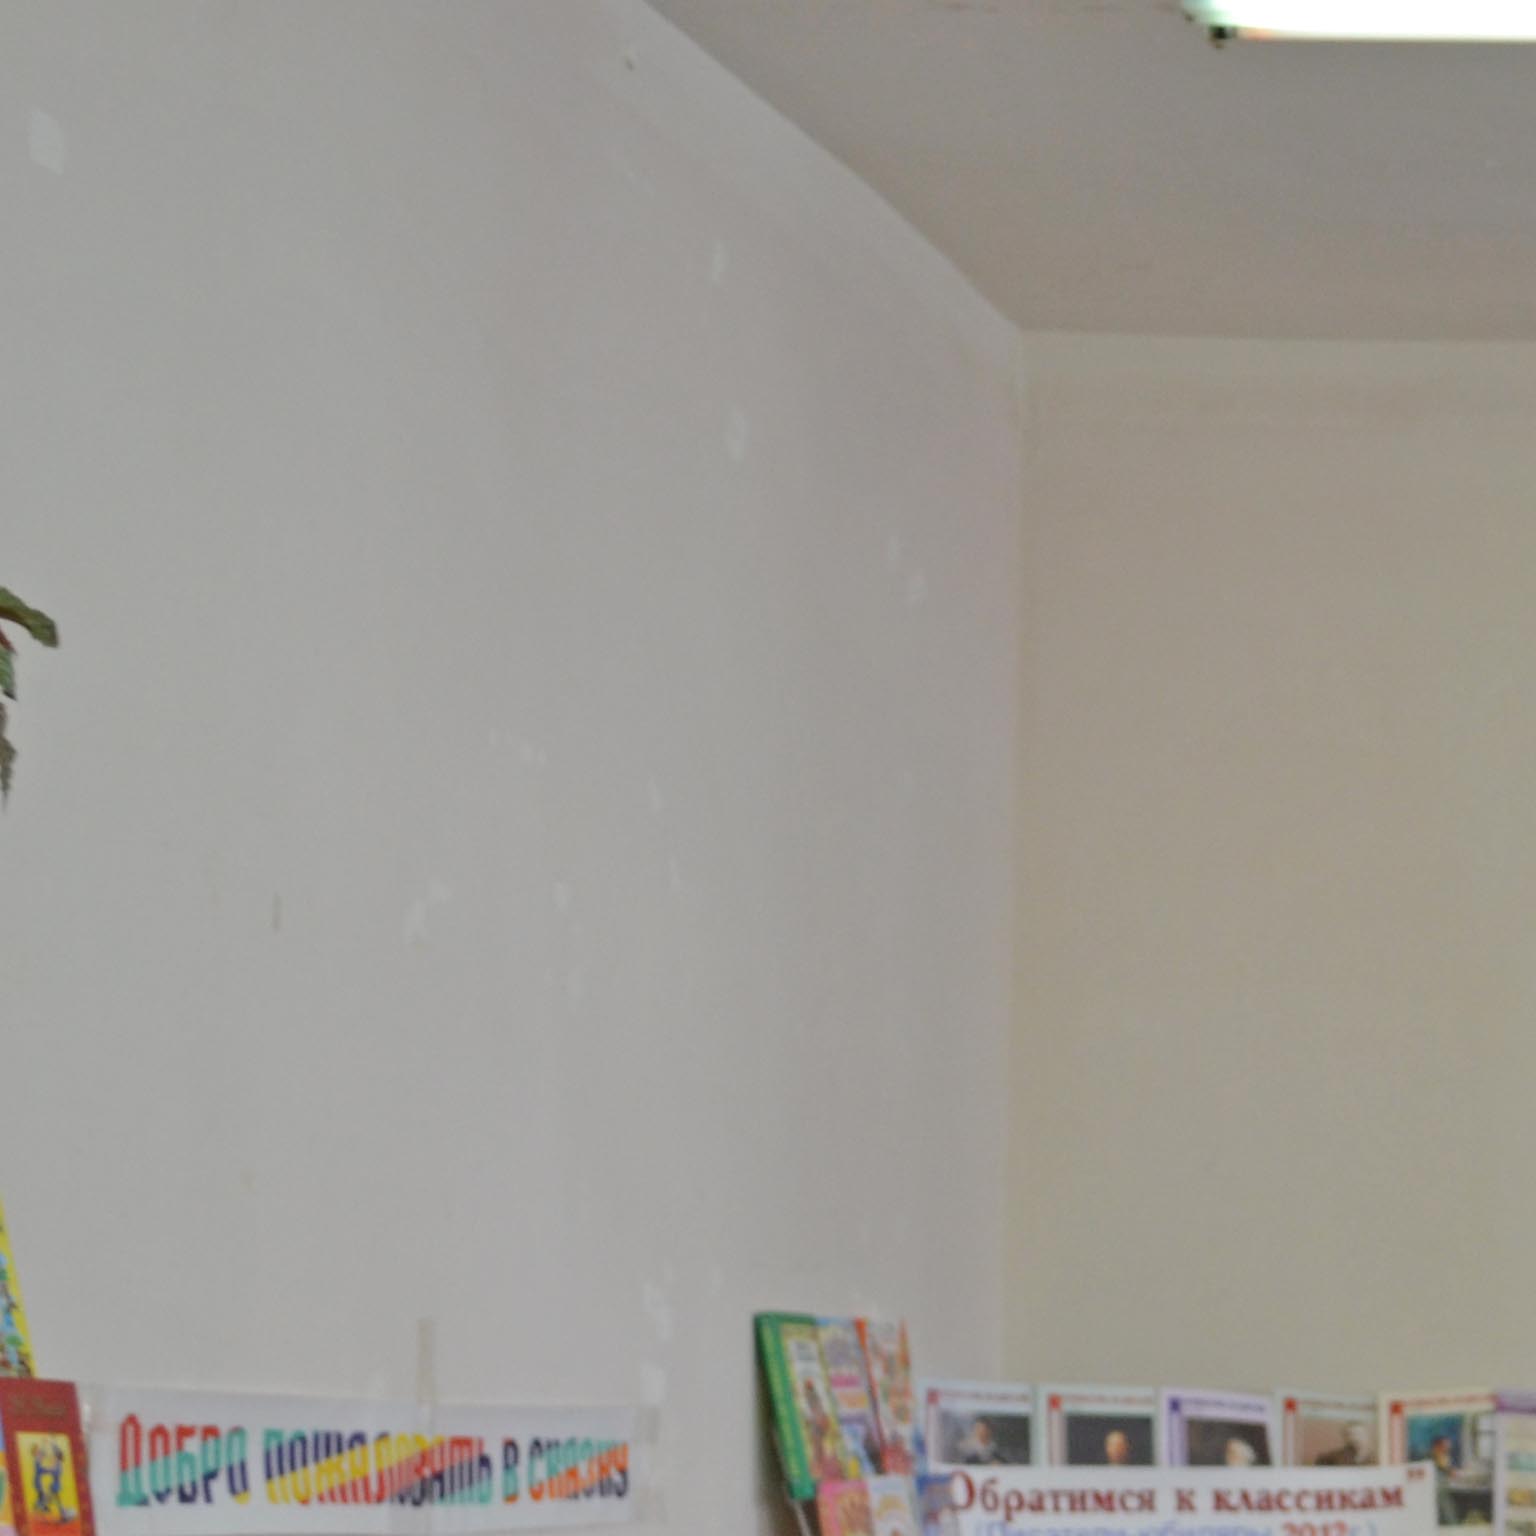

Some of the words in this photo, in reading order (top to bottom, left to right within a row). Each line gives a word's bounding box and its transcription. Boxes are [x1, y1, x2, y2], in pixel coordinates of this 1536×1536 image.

[116, 1413, 250, 1506] ДОБРО
[502, 1436, 519, 1503] В
[950, 1470, 1155, 1522] Обратимся
